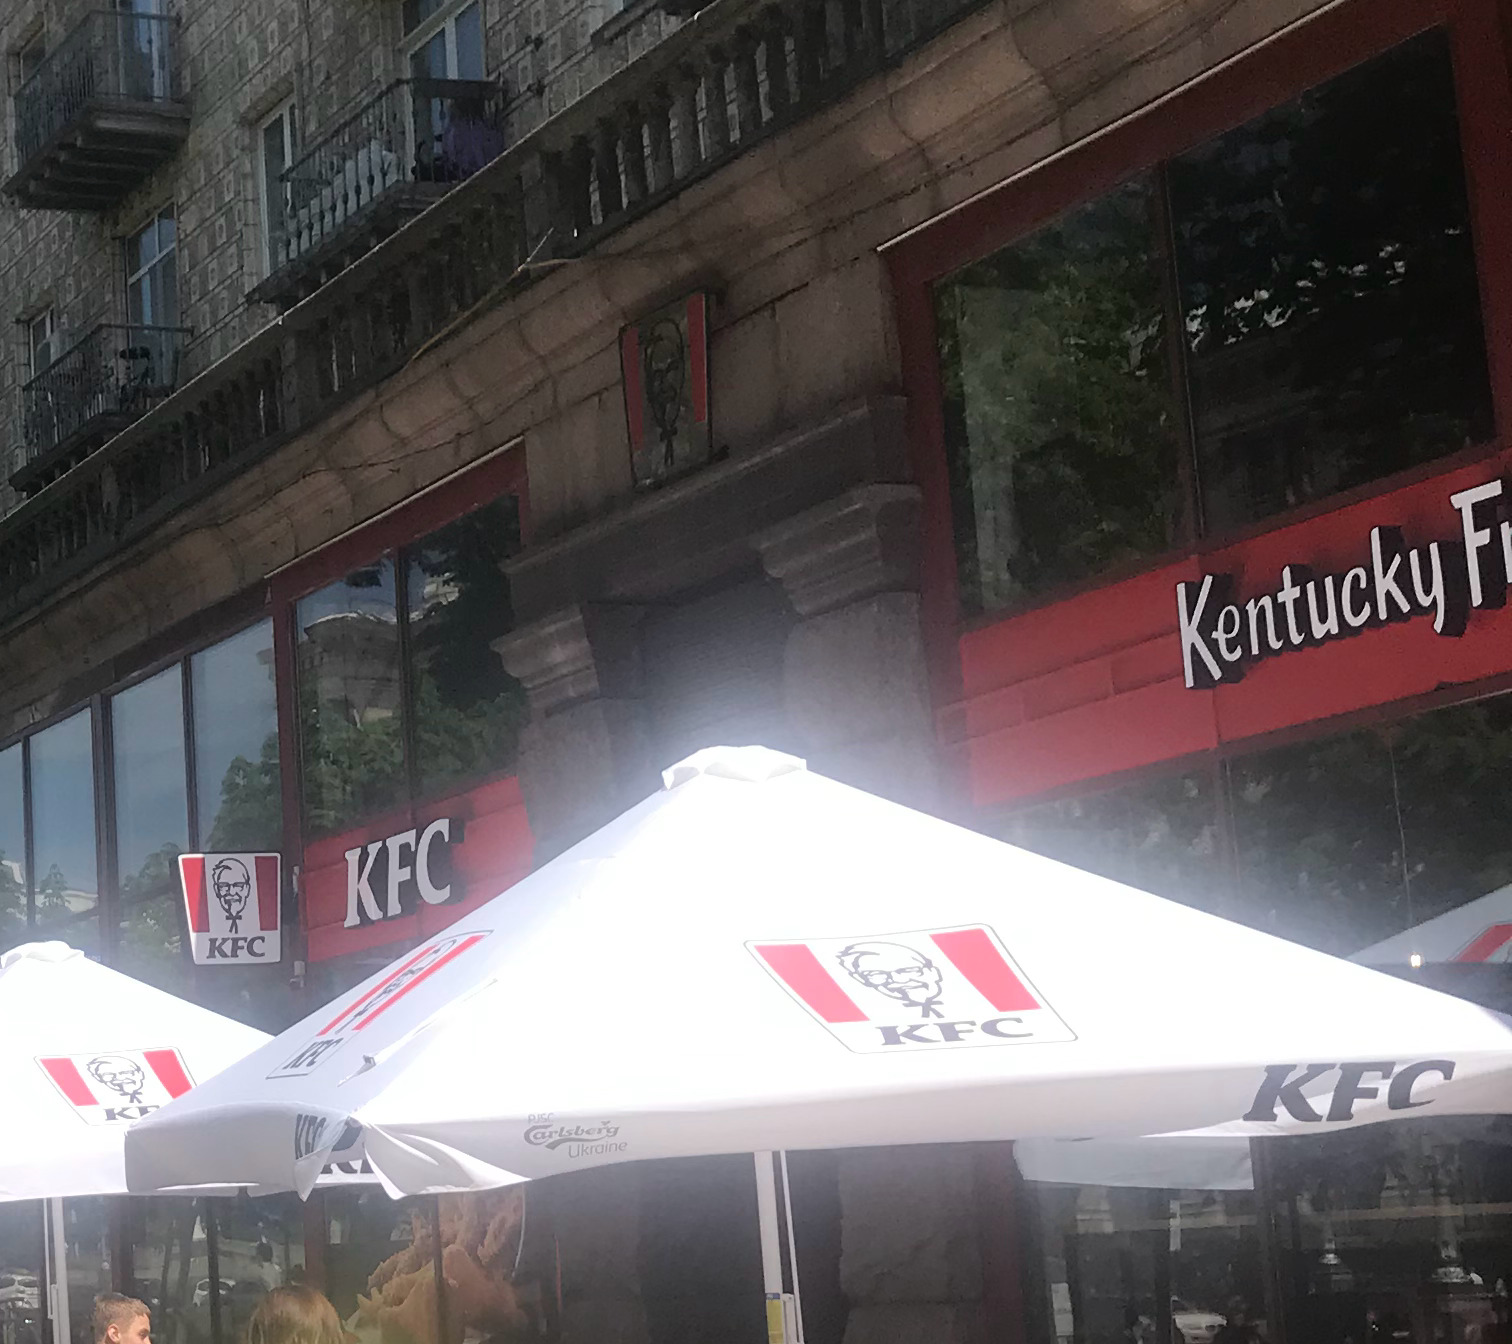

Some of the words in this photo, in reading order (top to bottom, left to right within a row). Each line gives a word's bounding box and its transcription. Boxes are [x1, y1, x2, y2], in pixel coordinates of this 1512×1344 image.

[1176, 526, 1445, 688] Kentucky
[343, 818, 451, 929] KFC
[206, 935, 266, 959] KFC
[875, 1017, 1034, 1046] KFC
[1242, 1059, 1456, 1122] KFC
[523, 1120, 620, 1151] Carlsberg
[568, 1141, 628, 1159] Ukraine
